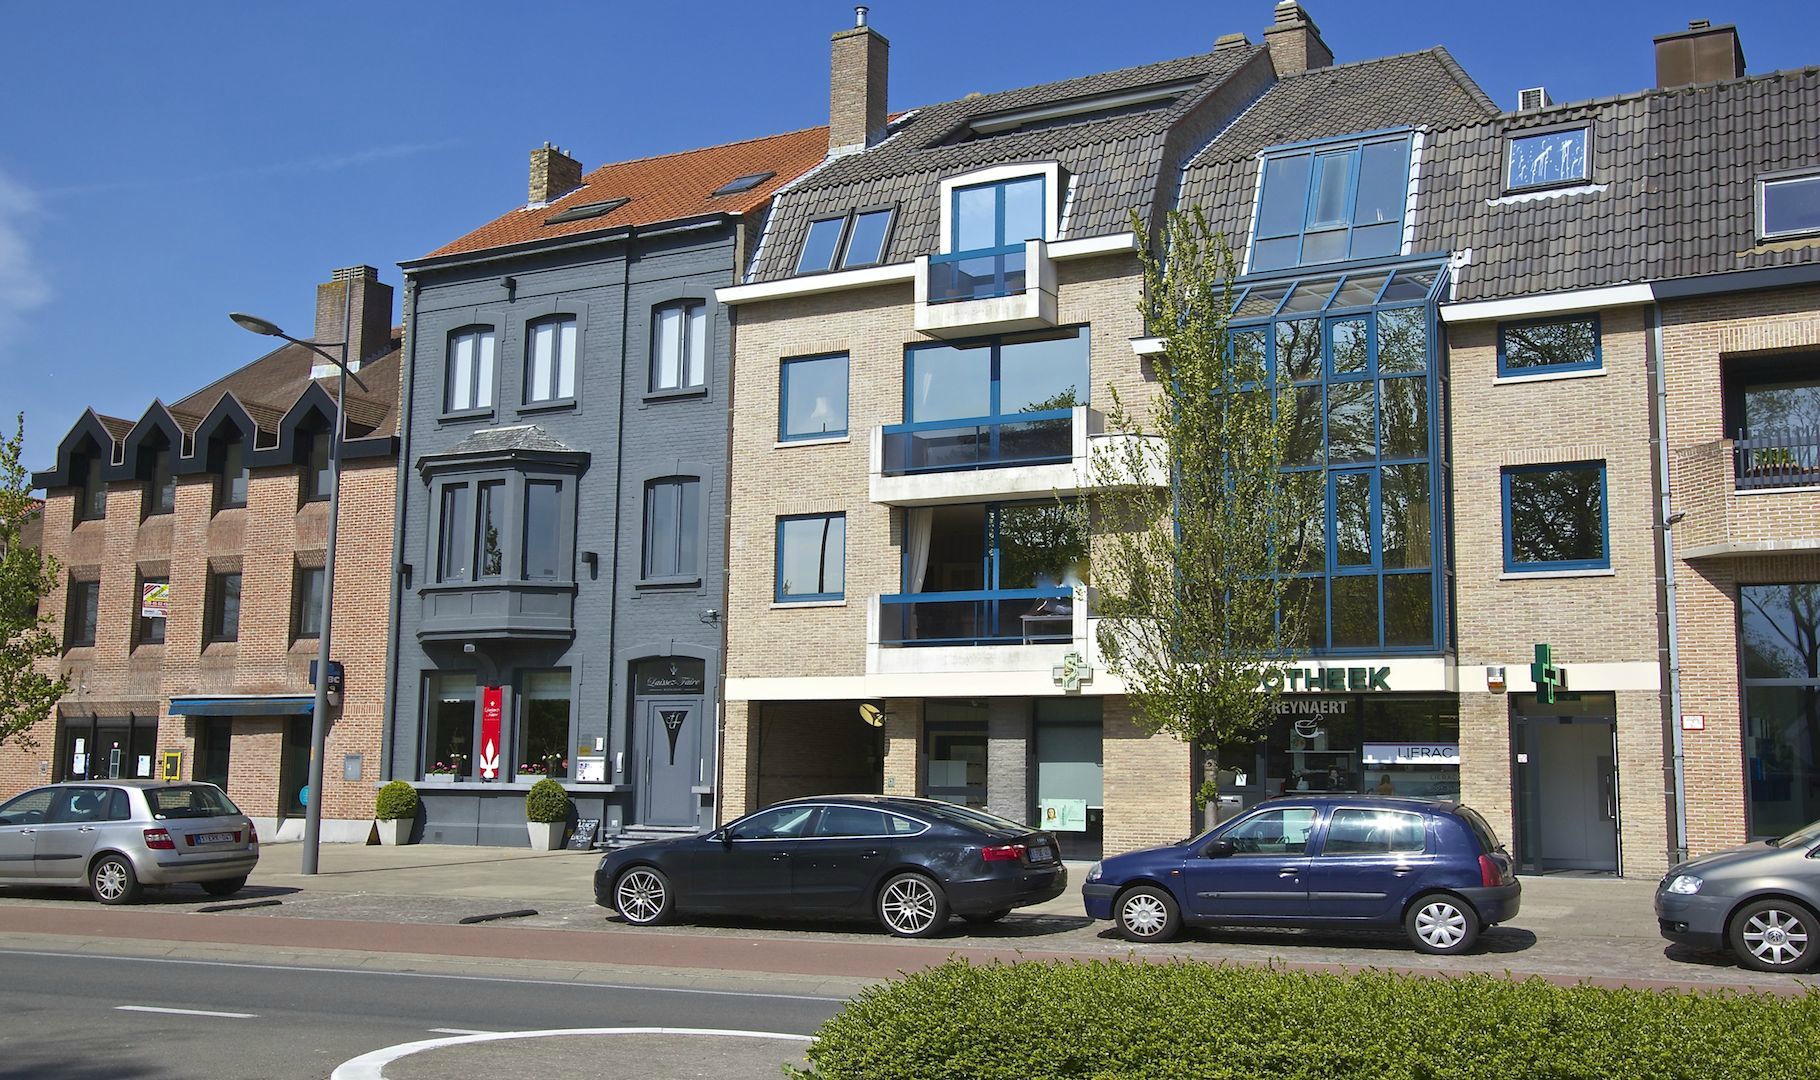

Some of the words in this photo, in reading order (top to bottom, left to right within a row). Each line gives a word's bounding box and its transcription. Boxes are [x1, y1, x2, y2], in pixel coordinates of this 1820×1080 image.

[327, 675, 340, 684] BC
[1242, 667, 1391, 692] OTHEEK
[1272, 700, 1348, 714] REYNAERT
[1397, 747, 1453, 759] LIERAC
